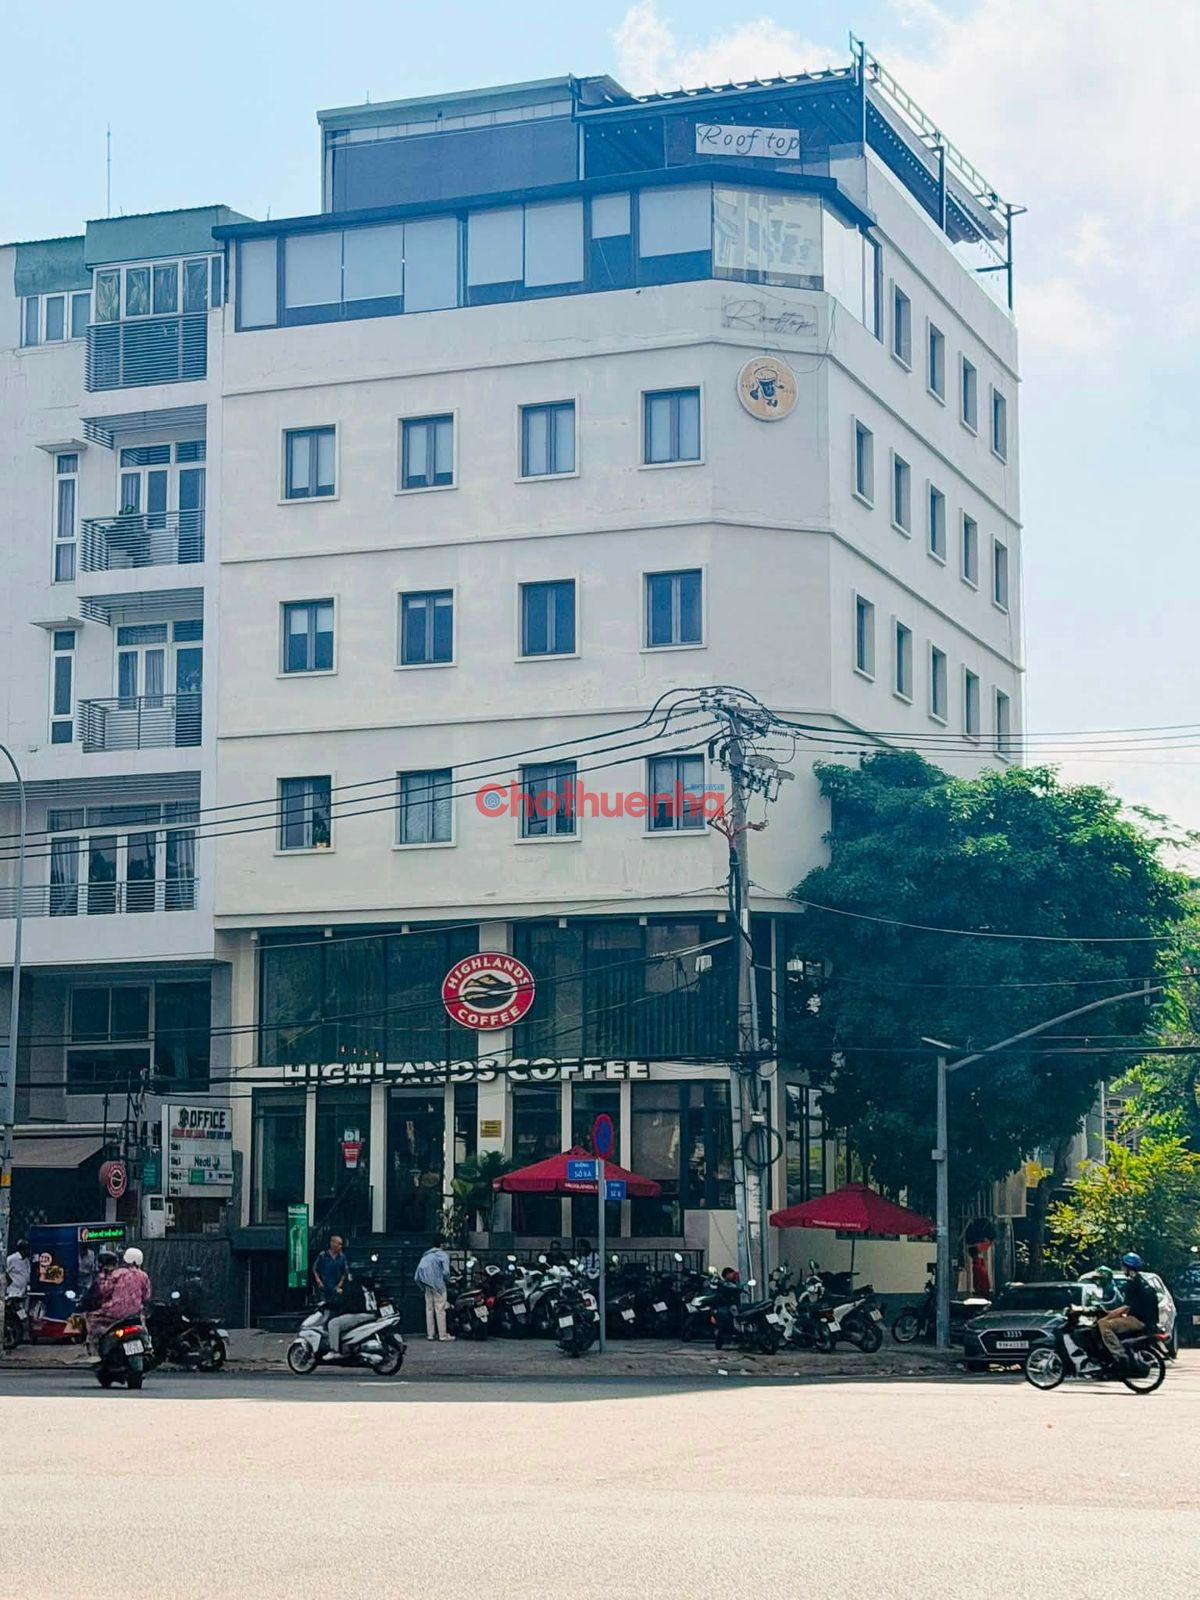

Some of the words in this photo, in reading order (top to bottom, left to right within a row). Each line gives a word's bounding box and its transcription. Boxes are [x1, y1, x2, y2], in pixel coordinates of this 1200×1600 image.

[447, 956, 530, 989] HIGHLANDS
[457, 1005, 520, 1026] COFFEE
[284, 1060, 497, 1086] HIGHLANDS
[506, 1057, 649, 1080] COFFEE
[189, 1110, 226, 1129] OFFICE
